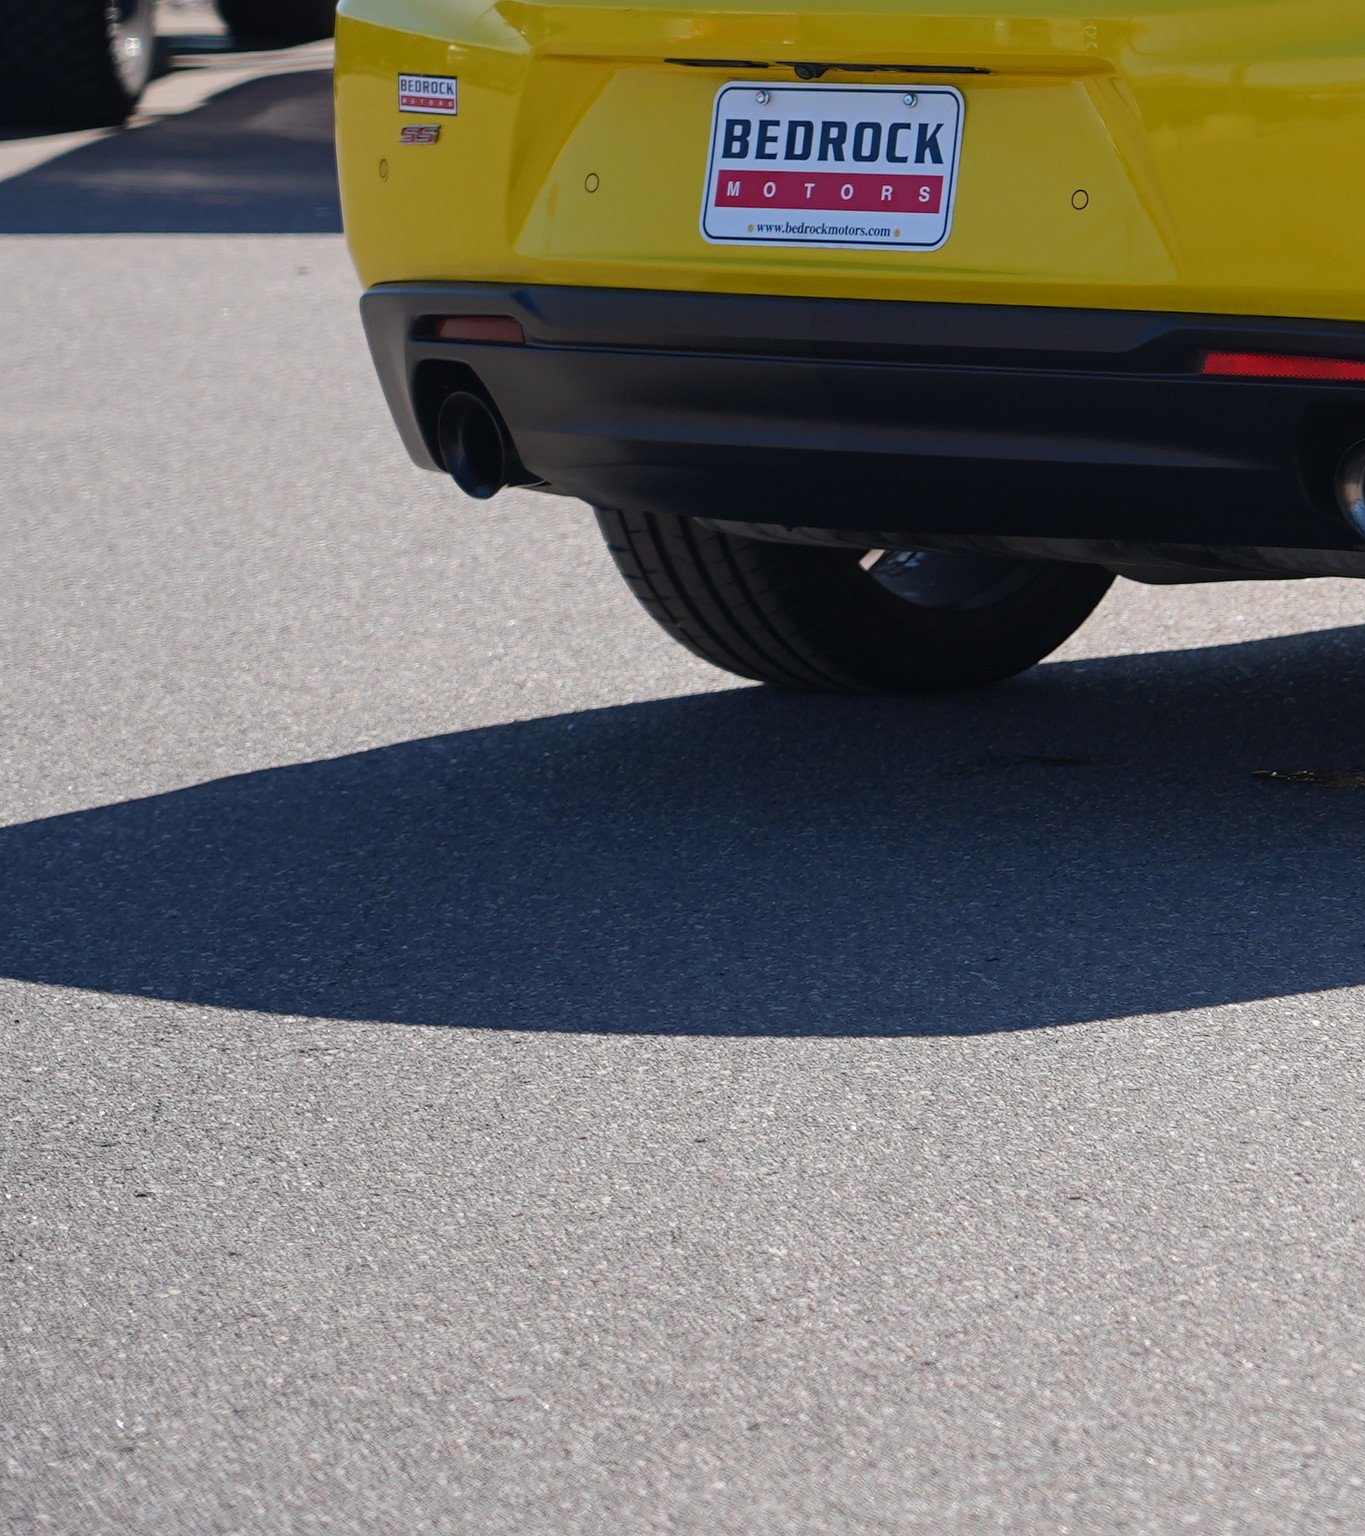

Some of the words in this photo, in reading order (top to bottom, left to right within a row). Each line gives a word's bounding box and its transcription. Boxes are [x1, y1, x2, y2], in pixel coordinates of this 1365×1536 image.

[400, 79, 454, 95] BEDROCK
[399, 125, 441, 145] SS
[722, 119, 944, 164] BEDROCK
[726, 181, 931, 203] MOTORS
[757, 222, 891, 237] www.bedrockmotors.com
